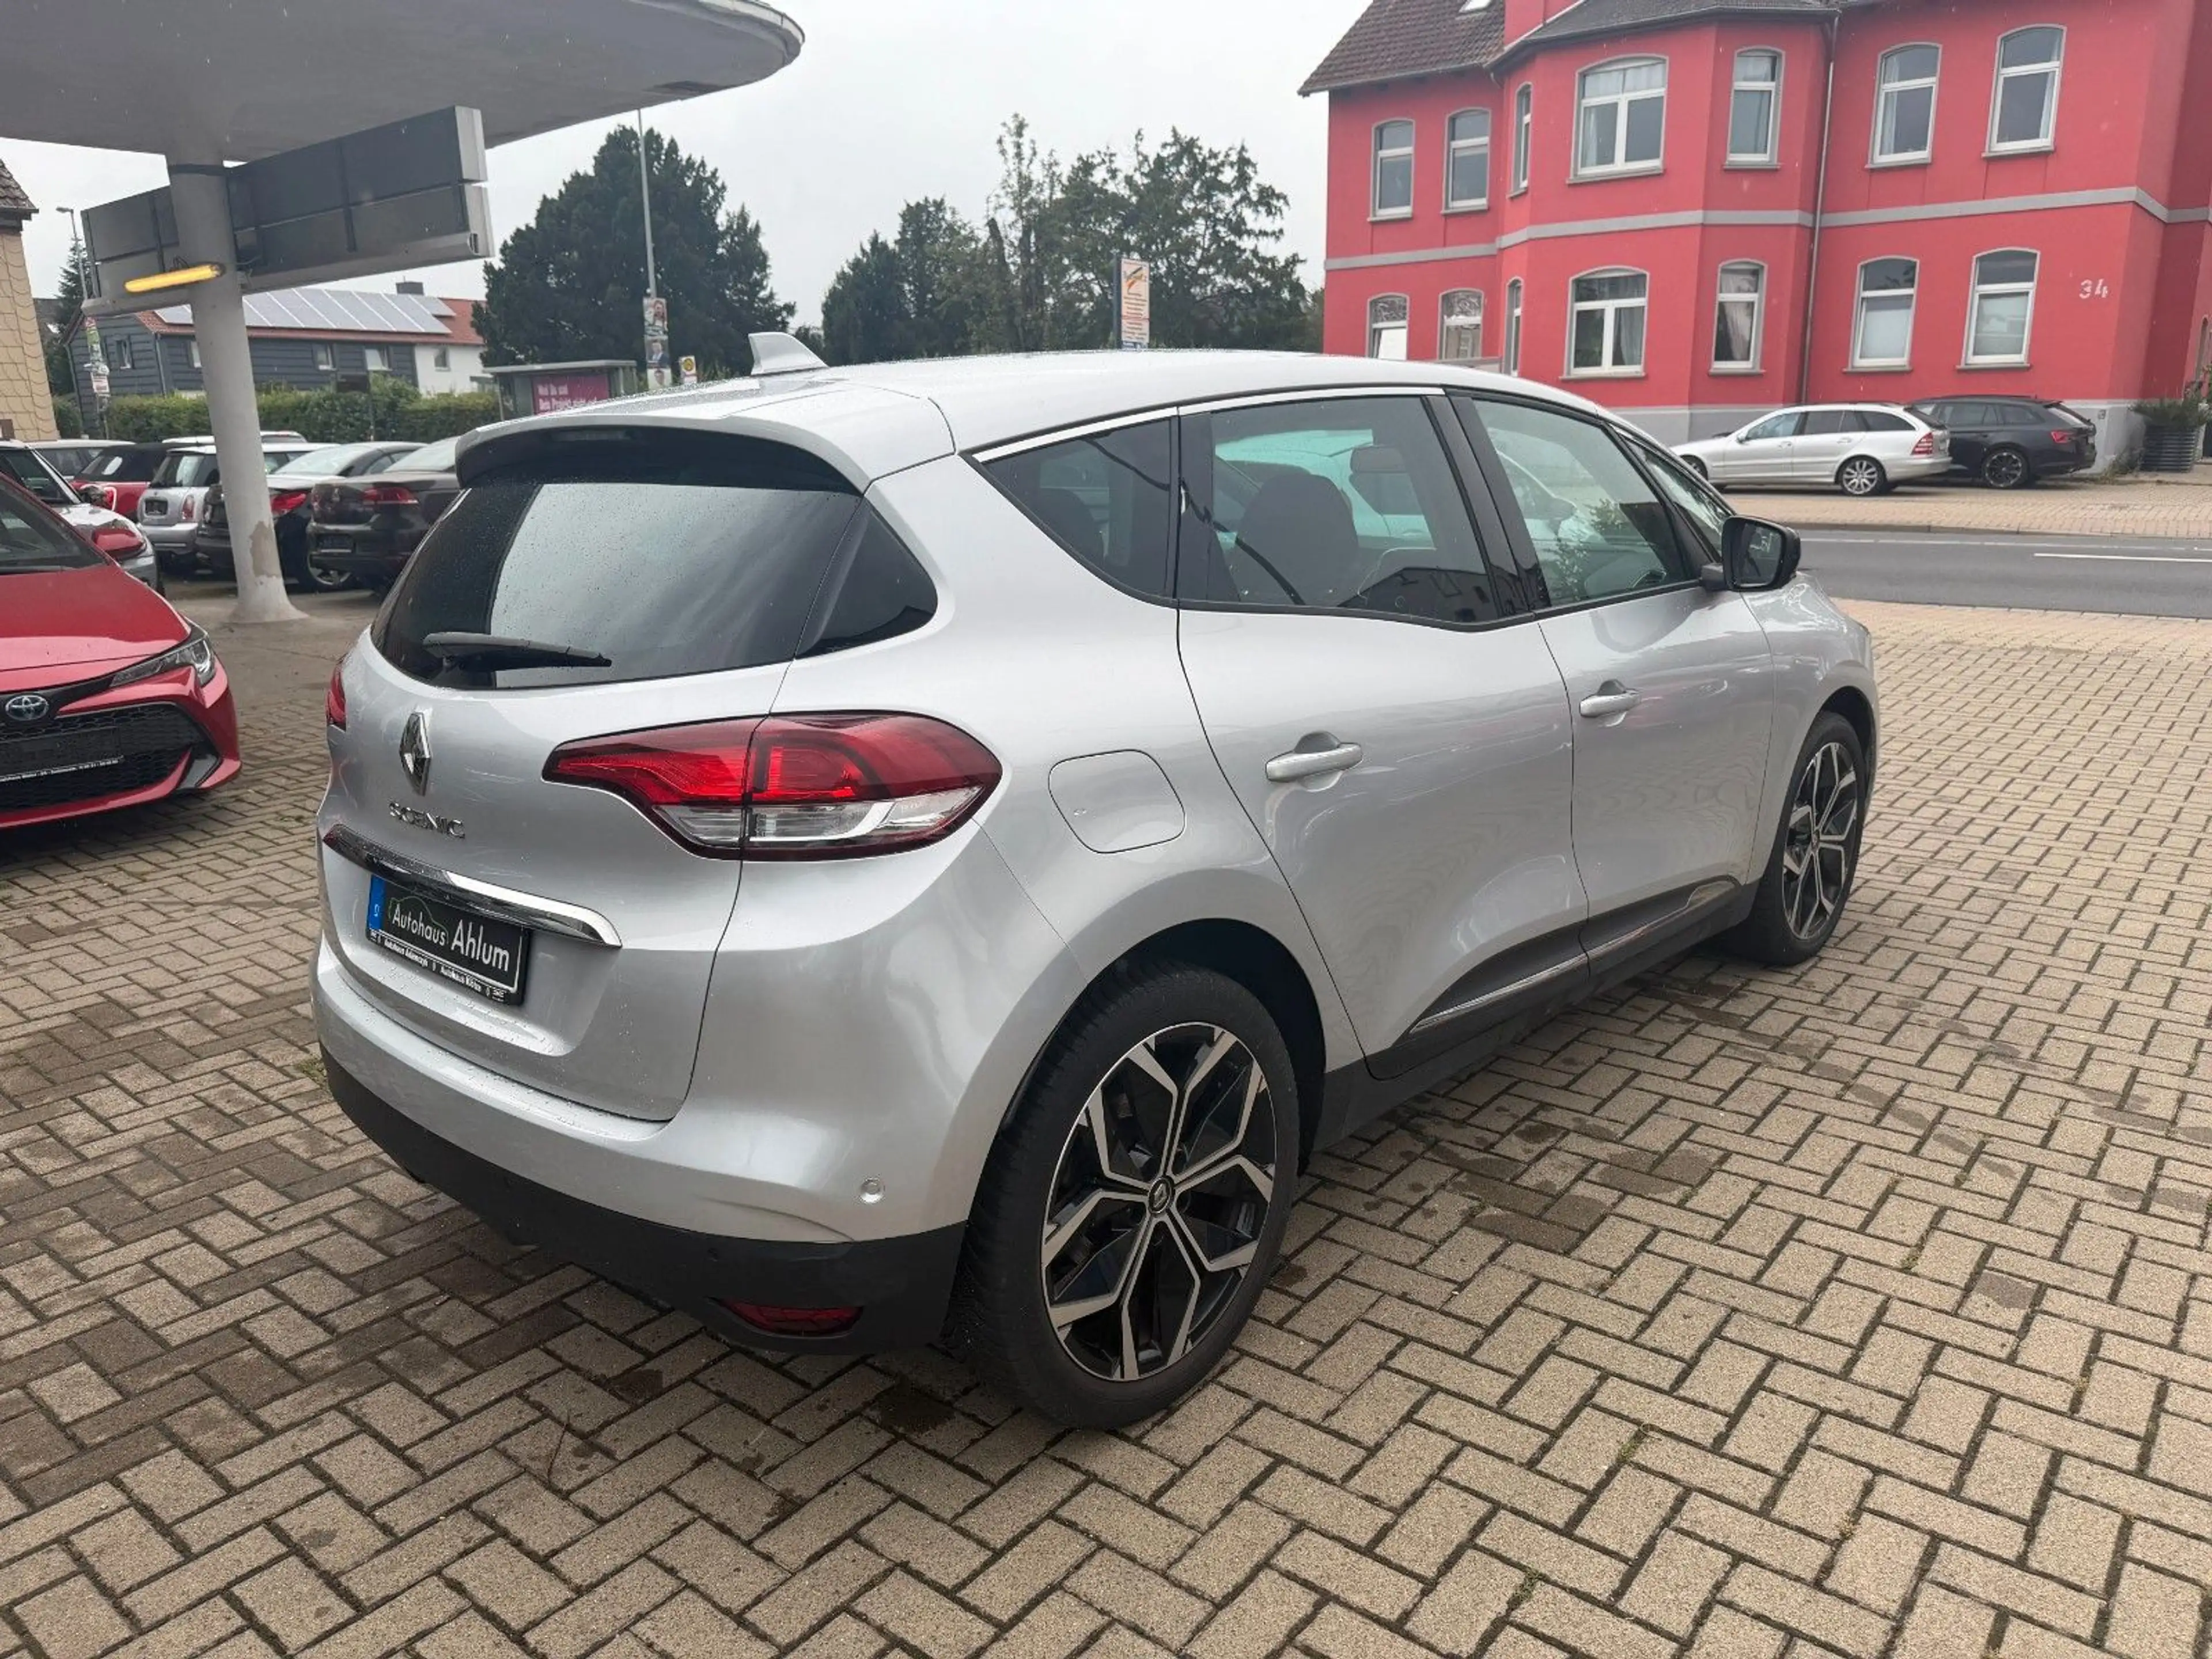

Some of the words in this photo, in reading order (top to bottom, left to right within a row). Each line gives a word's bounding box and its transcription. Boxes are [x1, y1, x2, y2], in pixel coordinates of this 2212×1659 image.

[2078, 279, 2108, 299] 34
[392, 903, 446, 946] Autohaus
[451, 919, 510, 972] Ahlum
